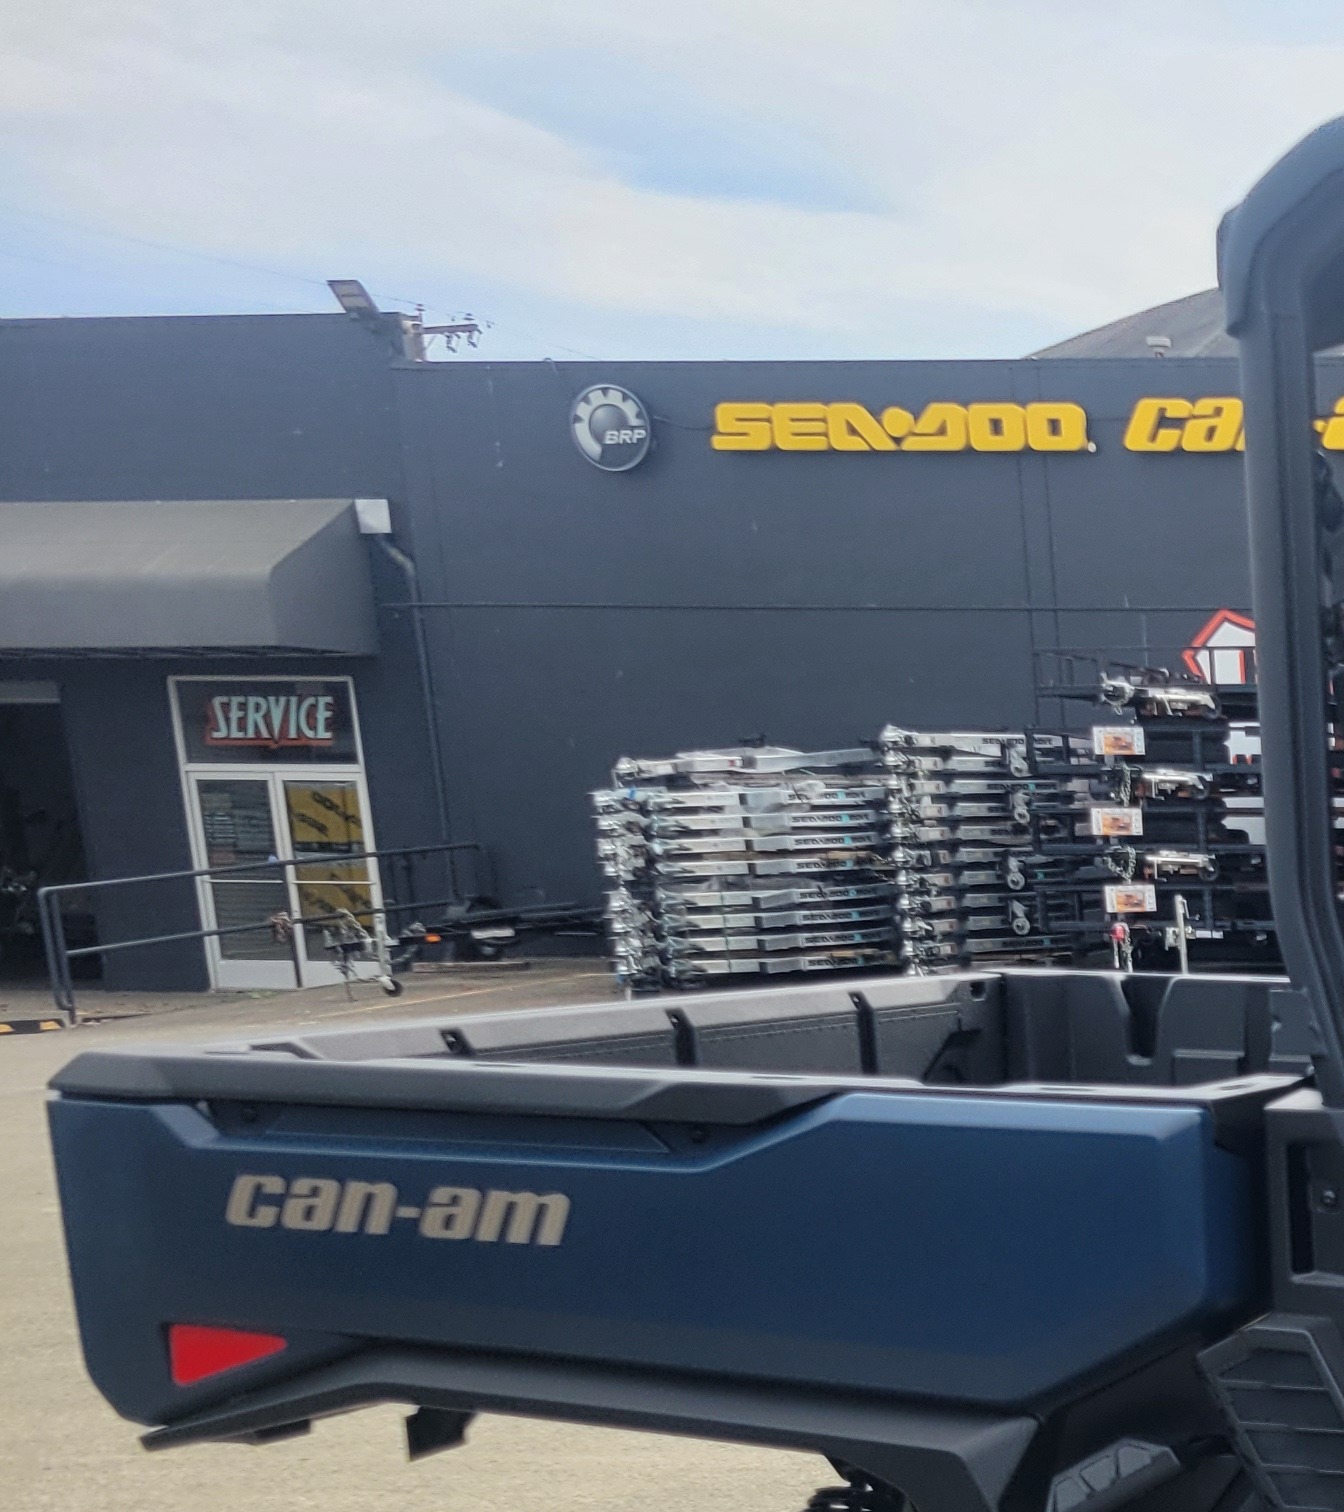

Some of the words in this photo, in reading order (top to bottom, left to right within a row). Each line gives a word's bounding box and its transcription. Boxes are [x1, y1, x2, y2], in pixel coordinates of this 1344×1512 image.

[604, 429, 647, 445] BRP
[211, 695, 334, 742] SERVICE
[225, 1174, 571, 1246] can-am
